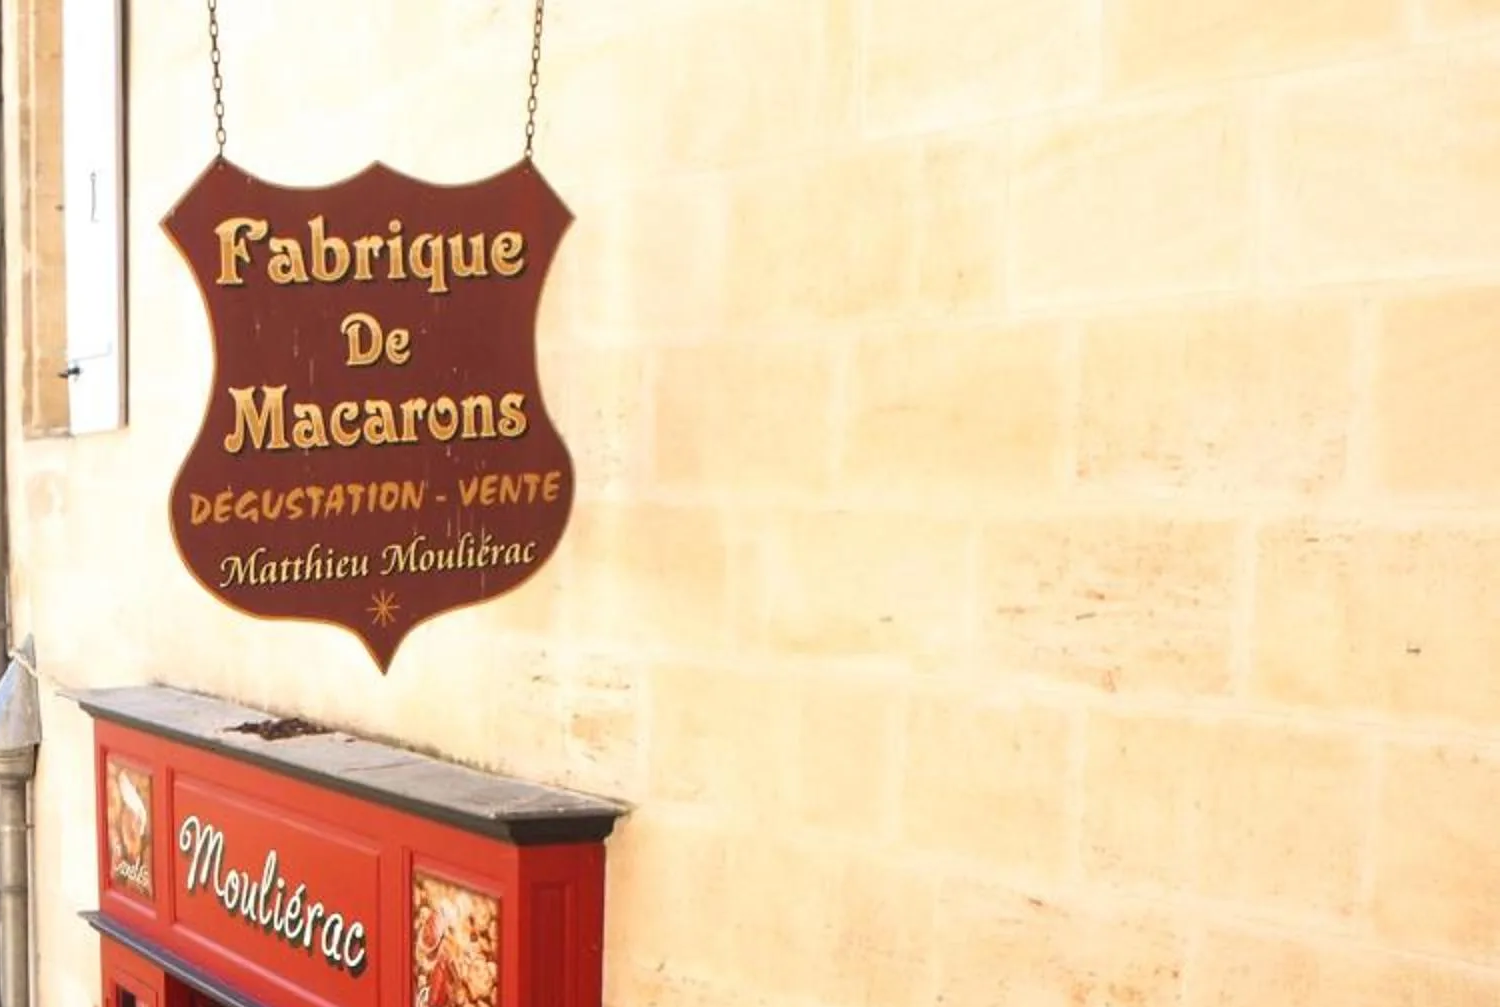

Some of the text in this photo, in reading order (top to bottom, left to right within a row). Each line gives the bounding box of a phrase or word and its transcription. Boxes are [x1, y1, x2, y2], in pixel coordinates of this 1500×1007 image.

[214, 214, 526, 294] Fabrique
[340, 312, 412, 367] De
[224, 384, 529, 454] Macarons
[459, 470, 563, 508] VENTE
[220, 532, 537, 589] Matthieu Mouliérac
[179, 814, 365, 968] Mouliérac
